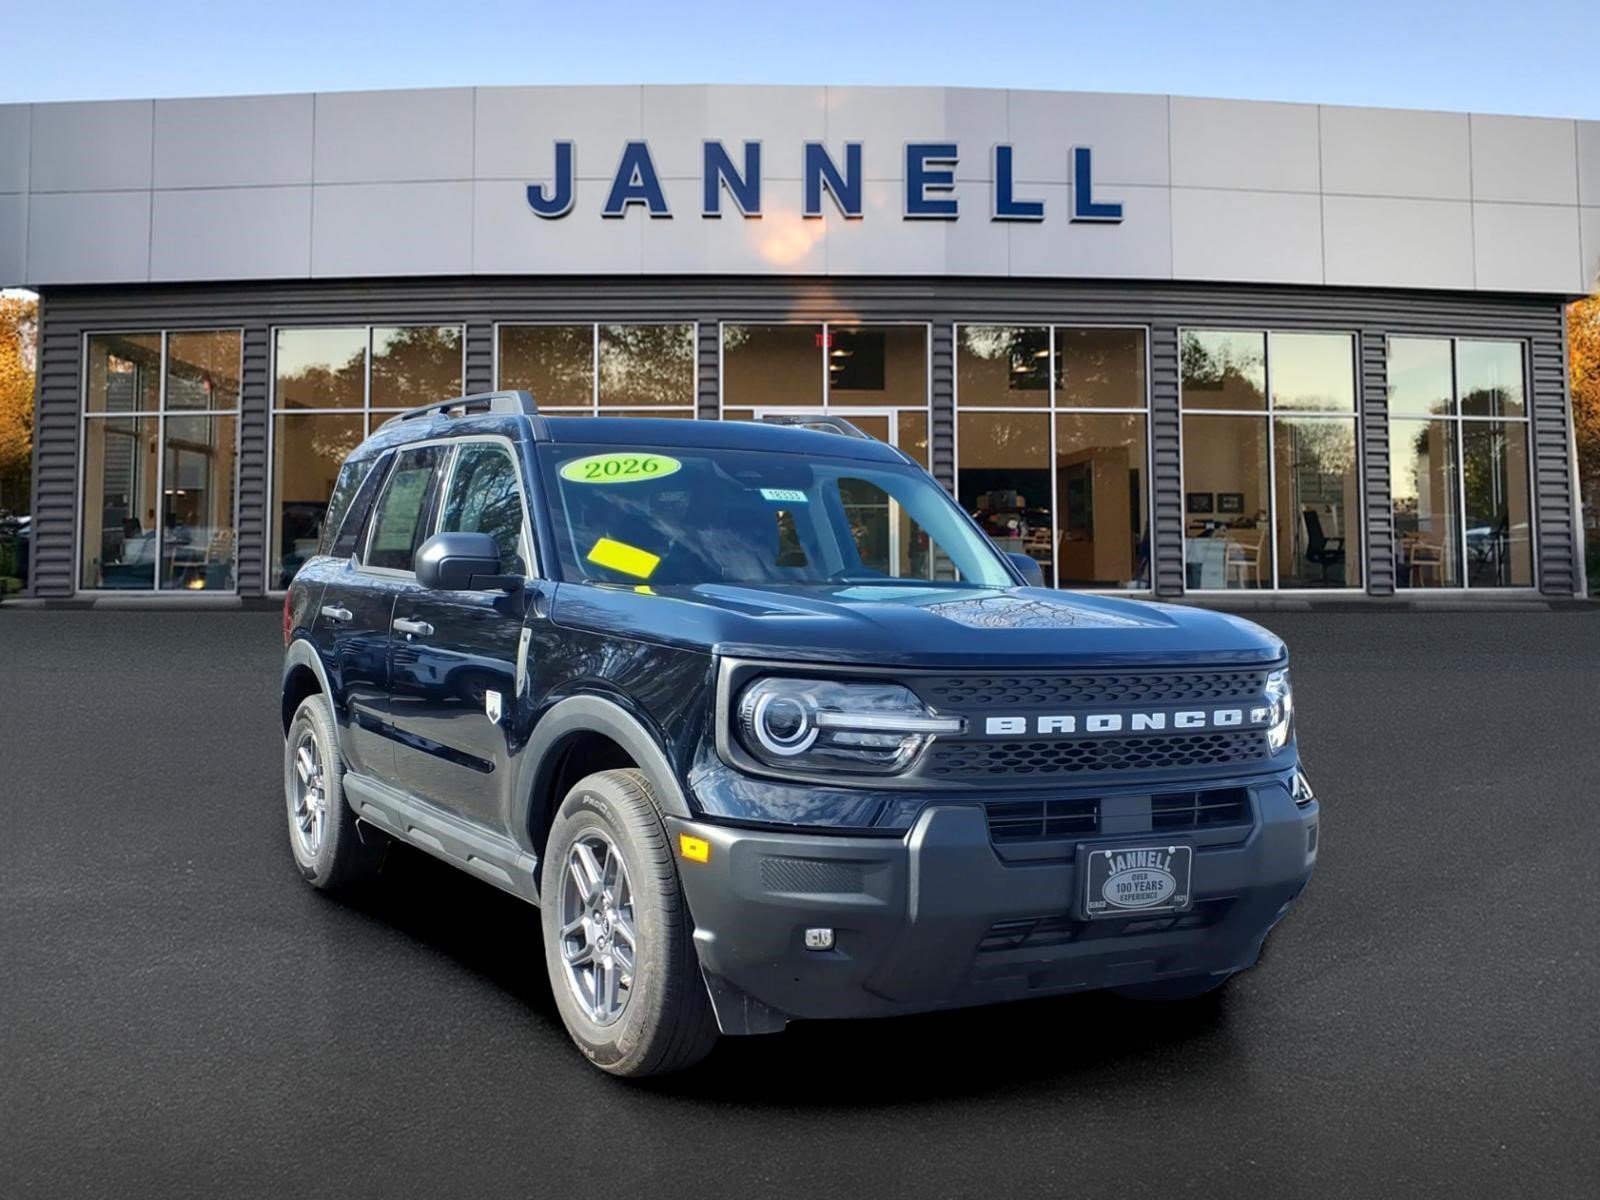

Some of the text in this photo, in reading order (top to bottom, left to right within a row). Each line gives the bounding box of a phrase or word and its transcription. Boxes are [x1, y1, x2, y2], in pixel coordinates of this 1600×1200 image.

[526, 138, 1124, 223] JANNELL
[585, 458, 658, 479] 2026
[985, 709, 1242, 735] BRONCO
[1108, 851, 1172, 876] JANNELL
[1116, 880, 1163, 894] 100 YEARS
[1132, 873, 1148, 881] OVER
